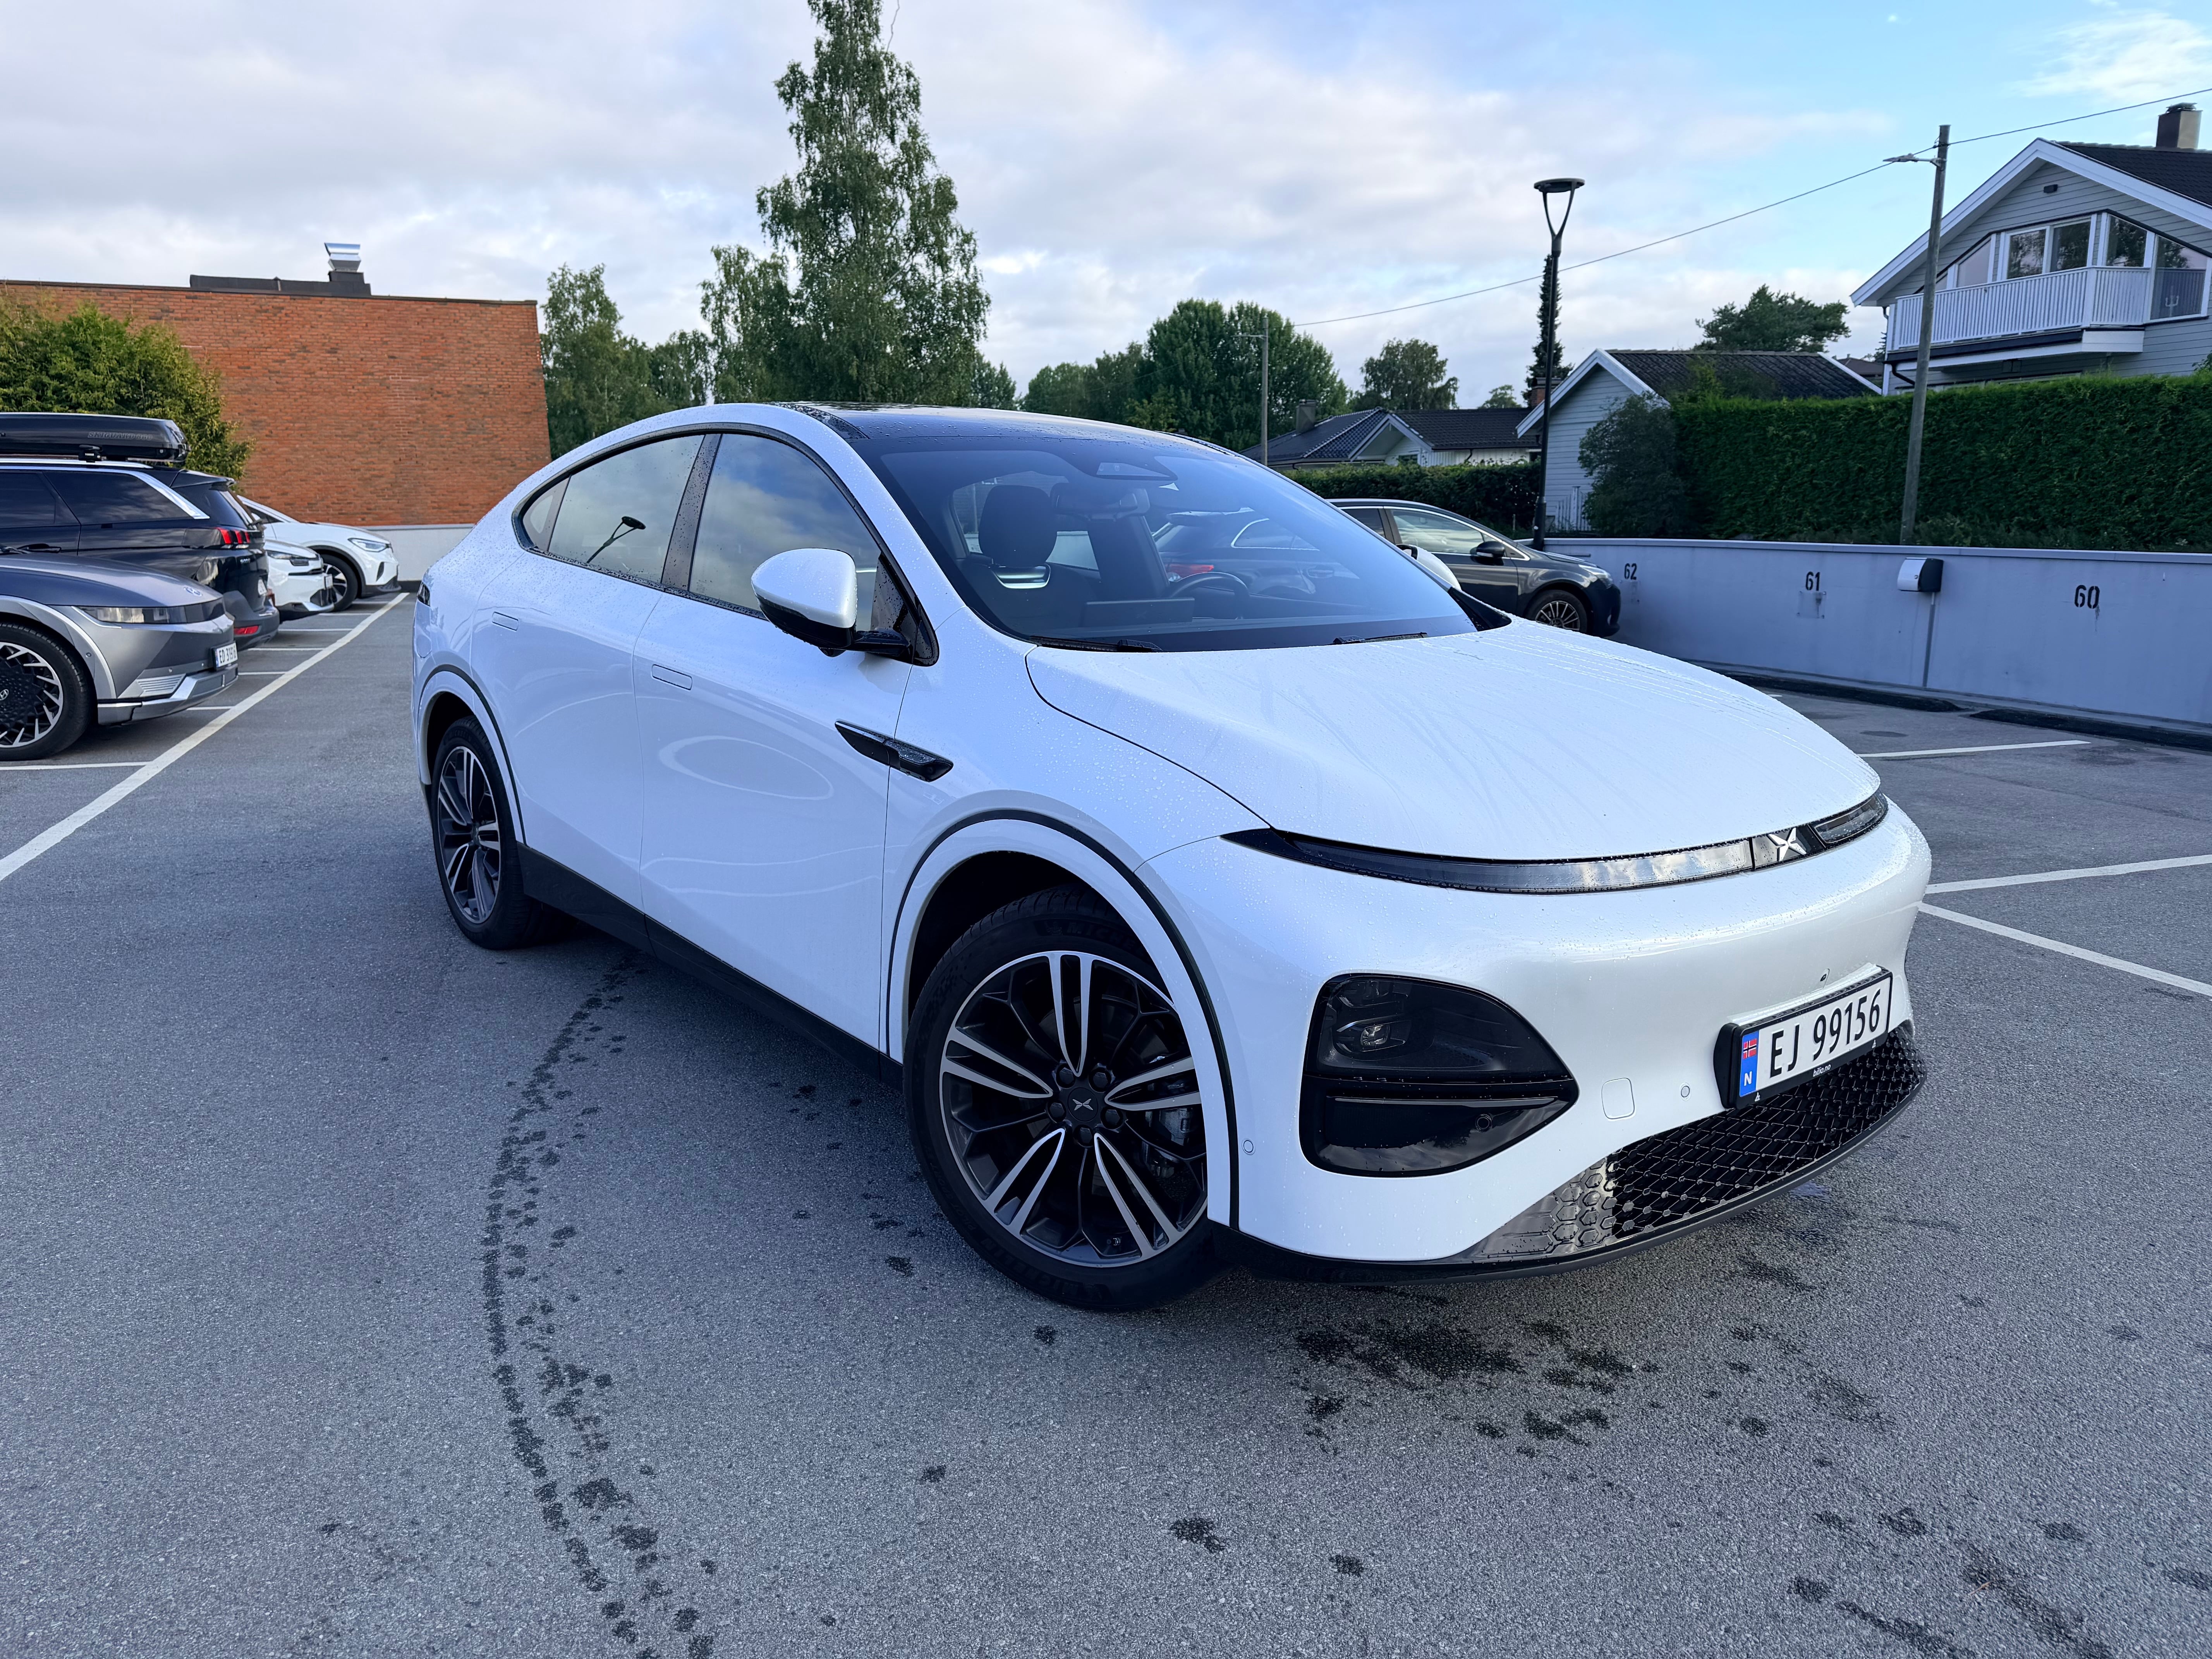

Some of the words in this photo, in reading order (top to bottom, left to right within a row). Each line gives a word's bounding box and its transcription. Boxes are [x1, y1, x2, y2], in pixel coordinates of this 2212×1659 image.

[1624, 563, 1637, 580] 62
[1805, 572, 1820, 591] 61
[2074, 584, 2100, 609] 60
[1769, 1023, 1800, 1078] EJ
[1812, 988, 1881, 1061] 99156
[1744, 1071, 1752, 1086] N
[1813, 1064, 1831, 1077] bilia.no
